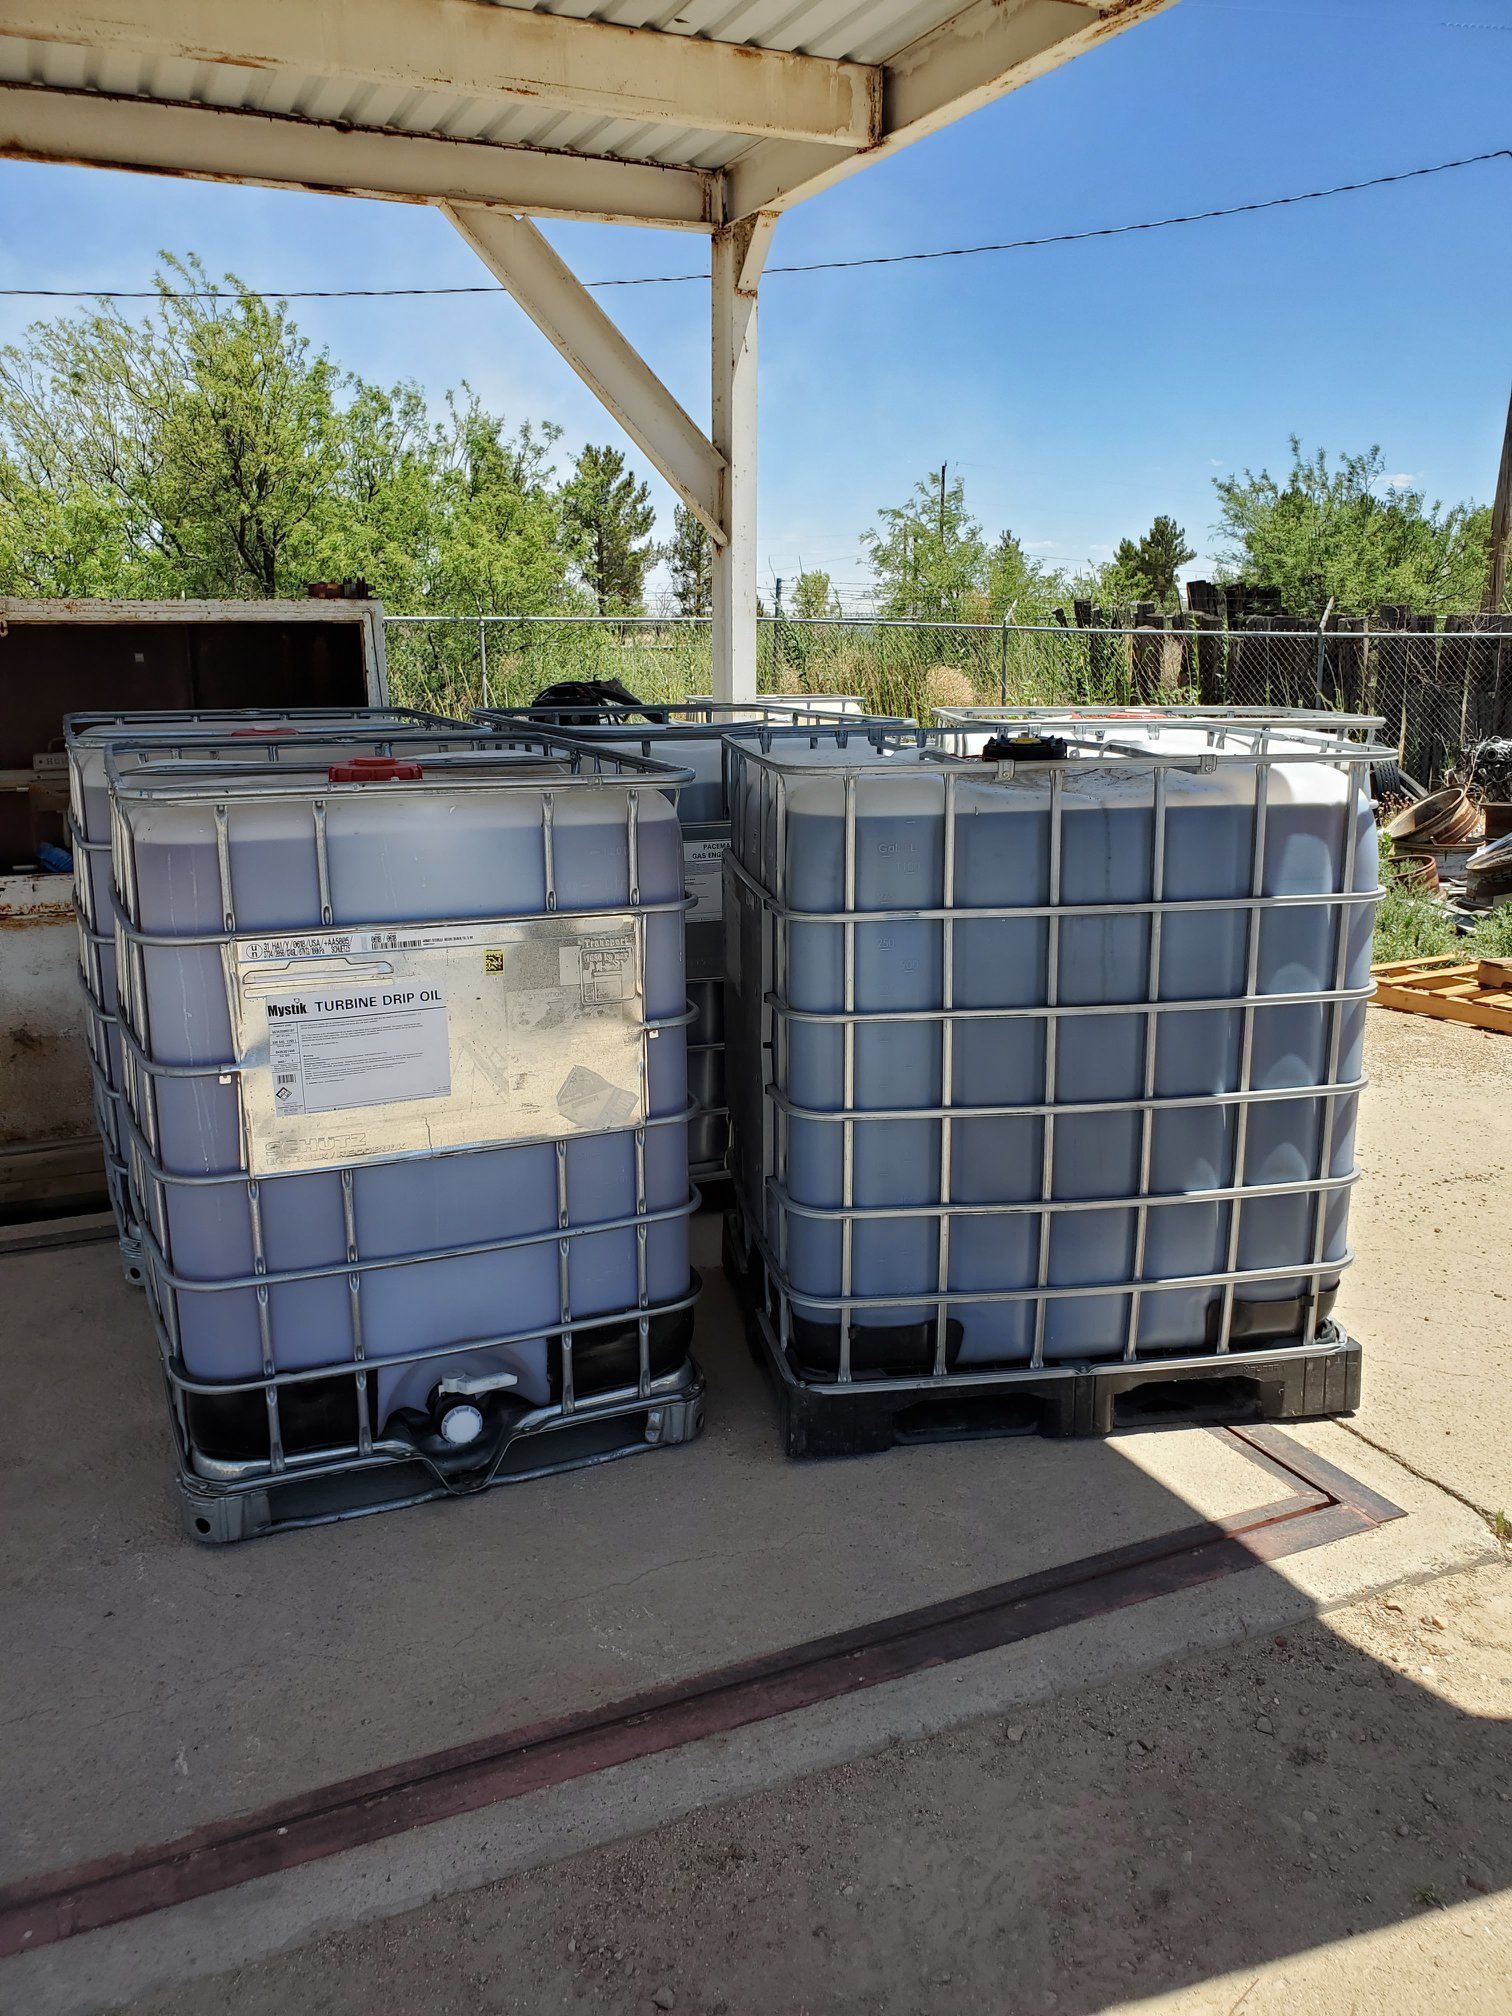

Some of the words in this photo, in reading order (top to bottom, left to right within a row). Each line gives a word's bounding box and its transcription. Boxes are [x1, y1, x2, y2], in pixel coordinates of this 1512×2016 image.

[267, 1001, 307, 1017] Mystik
[314, 996, 377, 1012] TURBINE
[382, 992, 415, 1006] DRIP
[420, 990, 442, 1001] OIL
